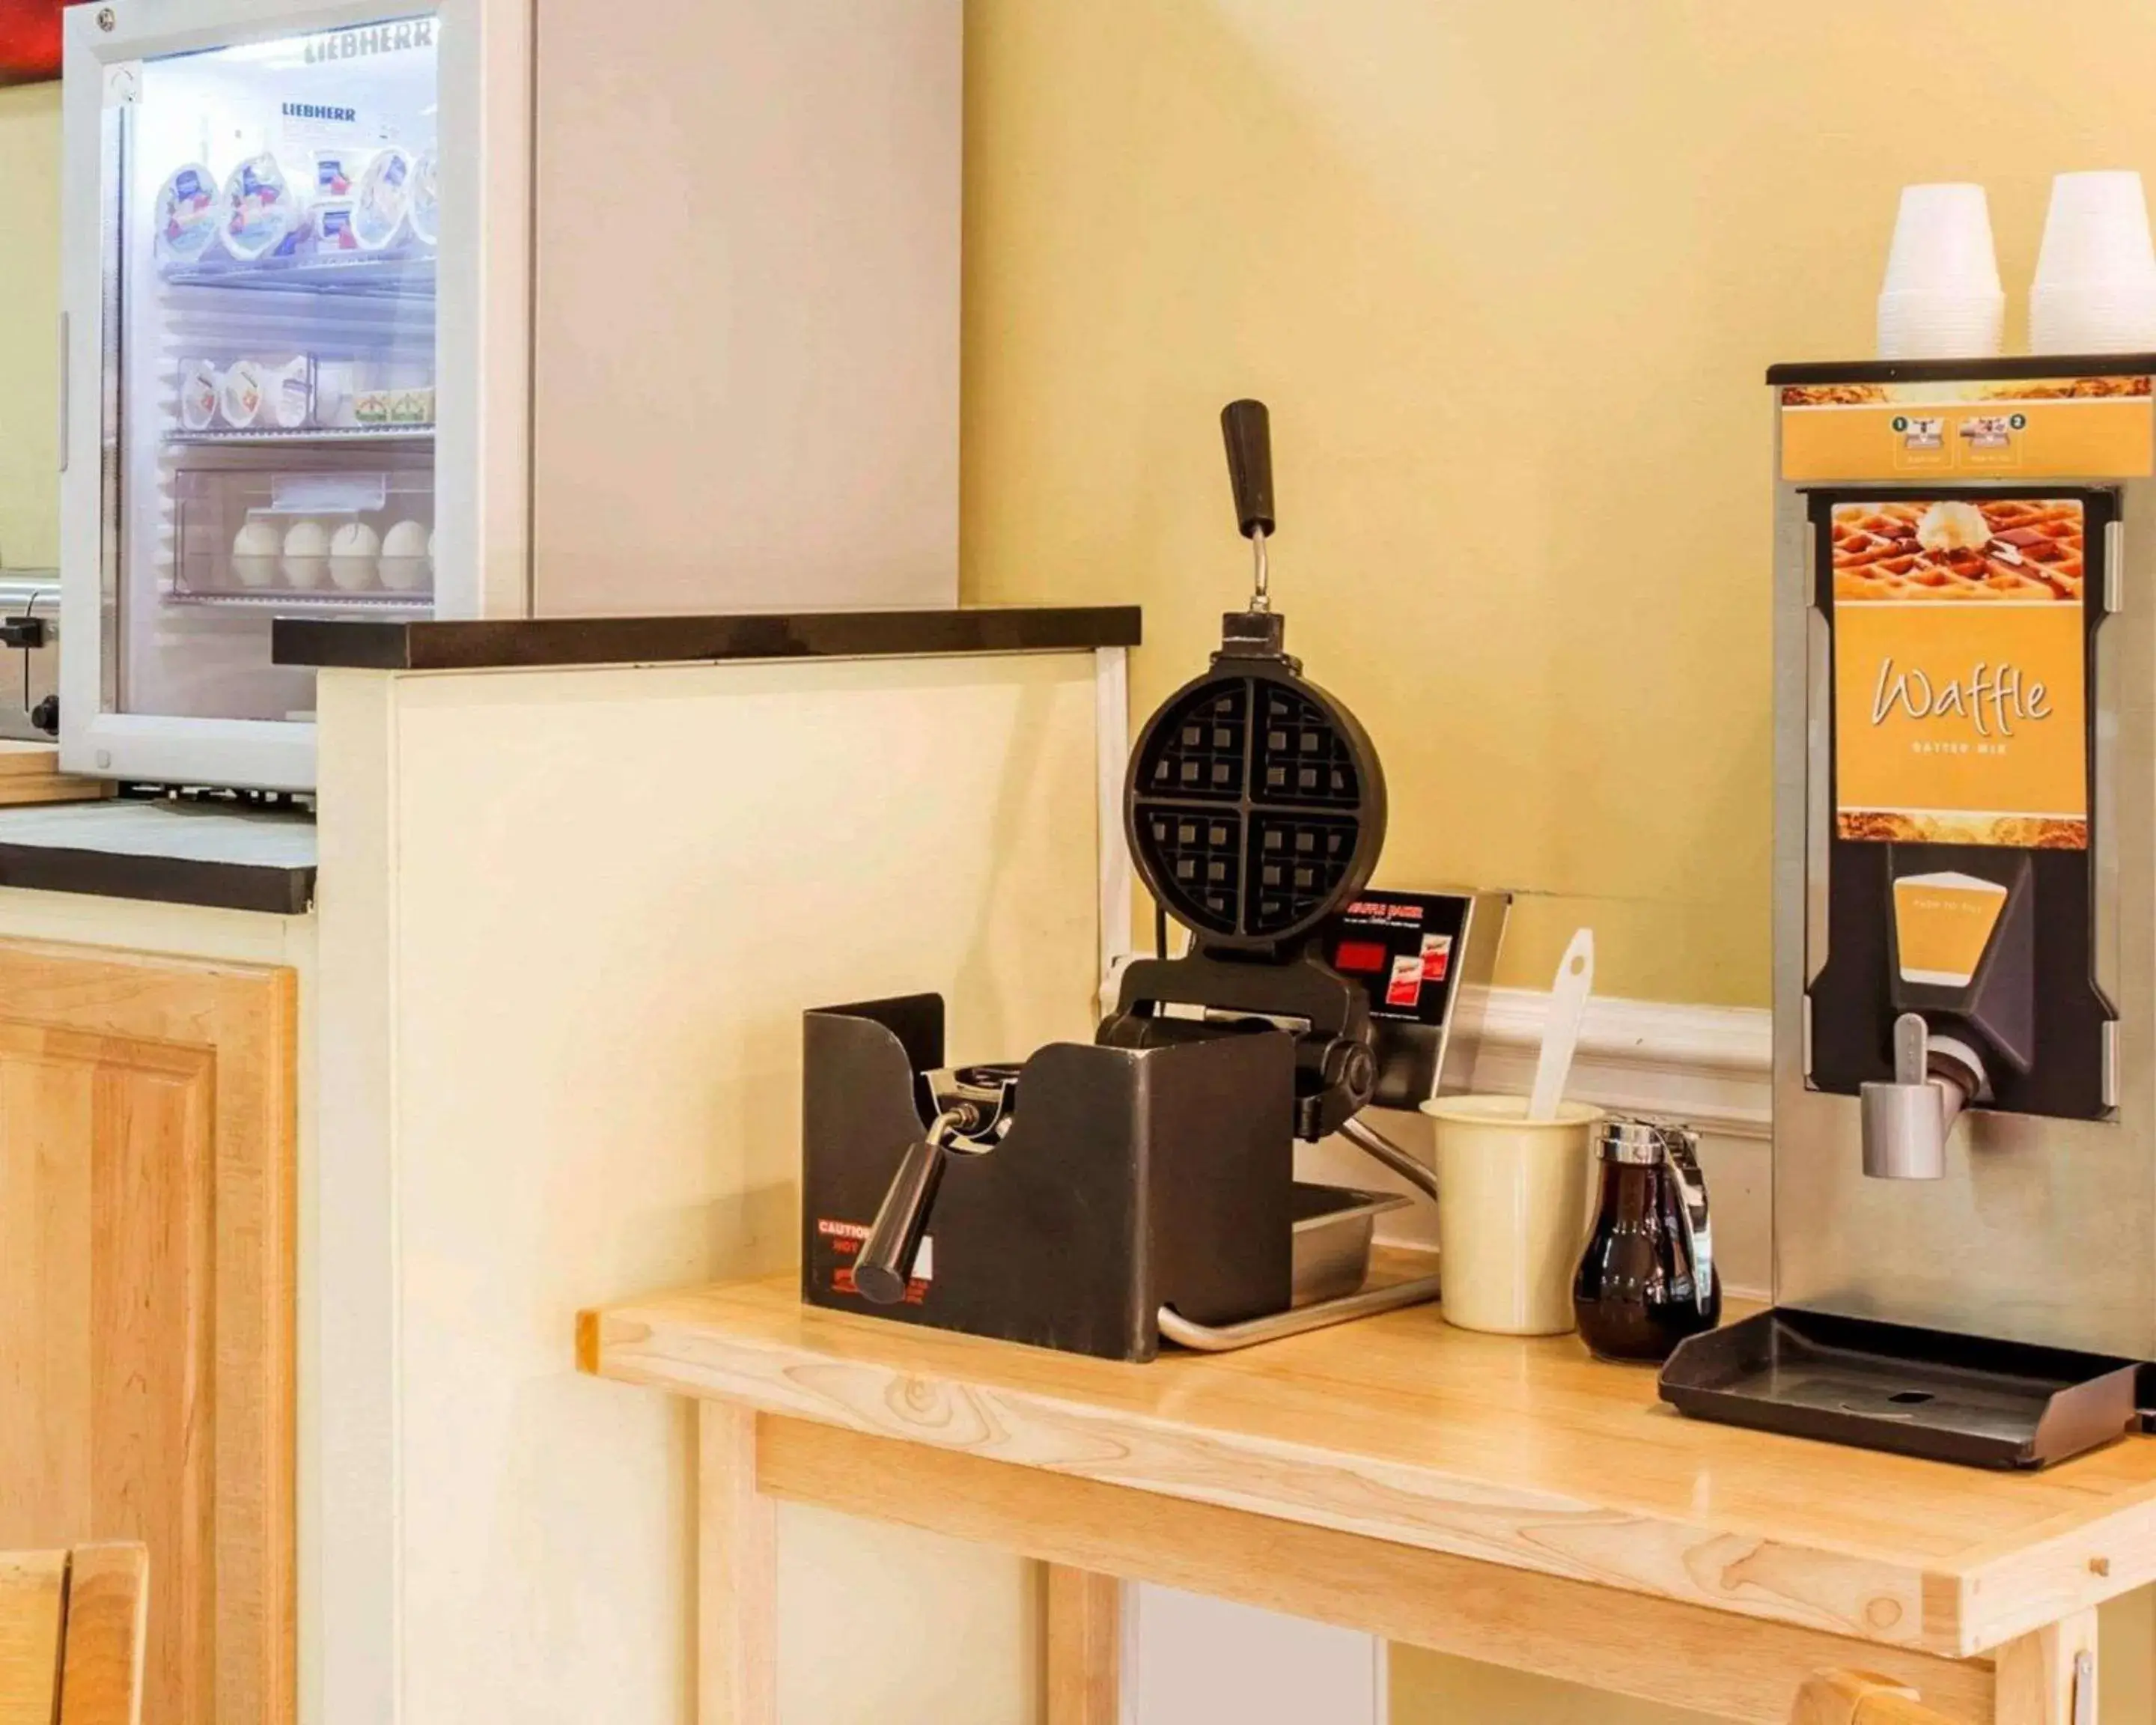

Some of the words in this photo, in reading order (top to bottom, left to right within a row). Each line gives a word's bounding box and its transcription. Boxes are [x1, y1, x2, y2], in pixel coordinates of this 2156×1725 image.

[304, 21, 433, 64] LIEBHERR
[281, 102, 356, 122] LIEBHERR
[1872, 656, 2053, 737] Waffle
